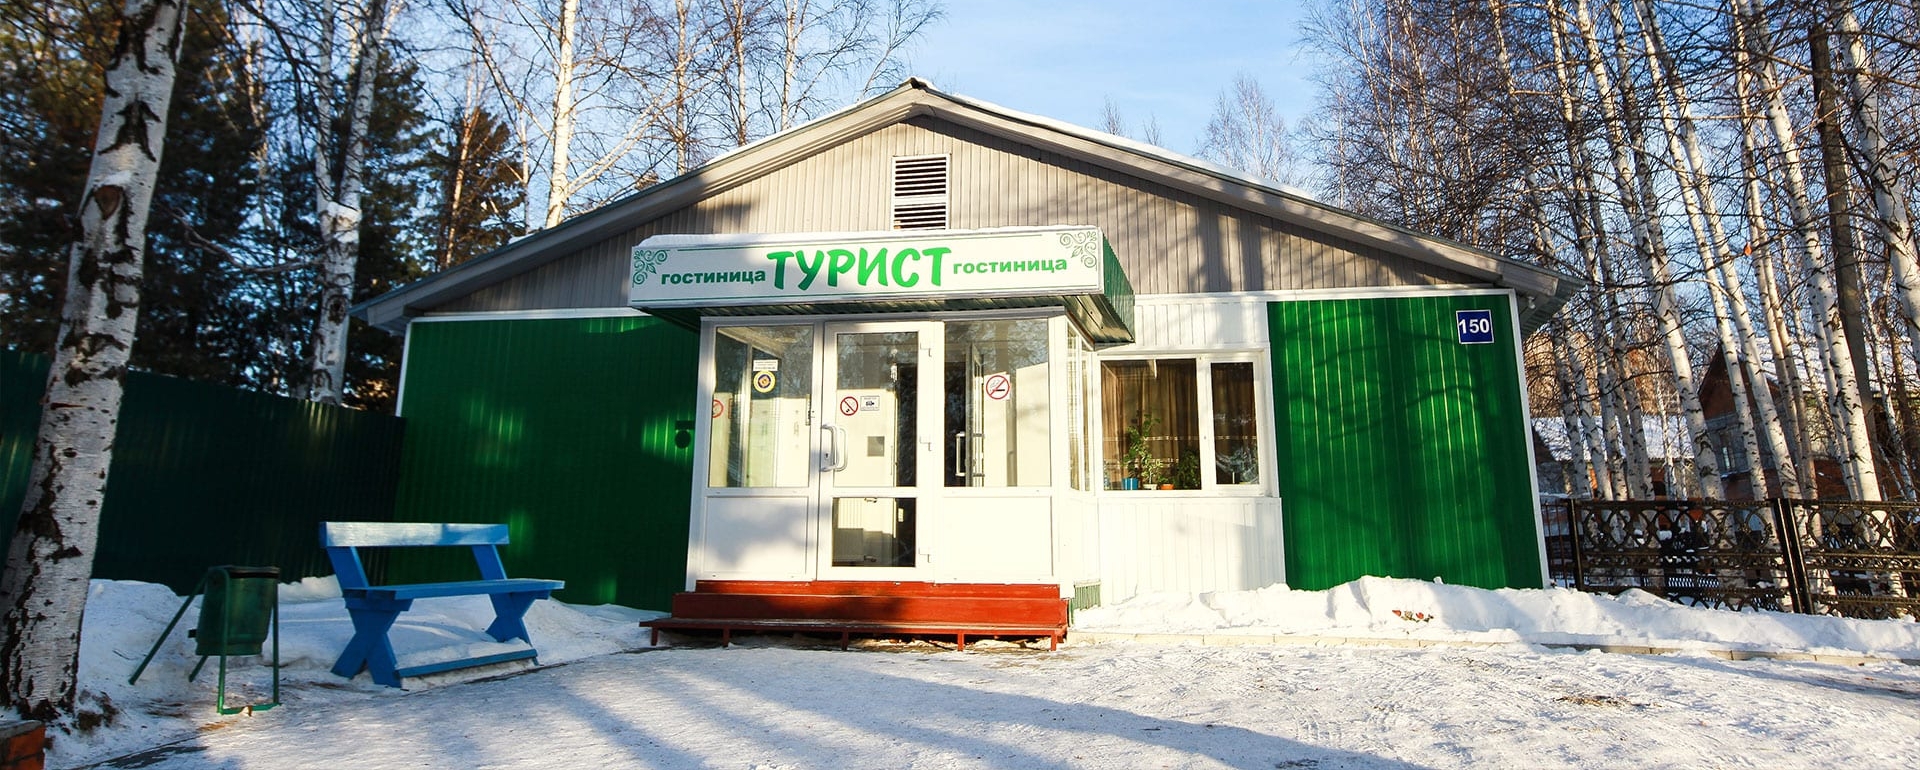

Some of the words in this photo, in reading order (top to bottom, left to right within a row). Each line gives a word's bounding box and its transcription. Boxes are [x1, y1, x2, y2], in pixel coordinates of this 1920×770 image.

[661, 270, 766, 285] гостиница
[766, 247, 952, 291] ТУРИСТ
[953, 258, 1067, 275] гостиница
[1459, 318, 1490, 334] 150
